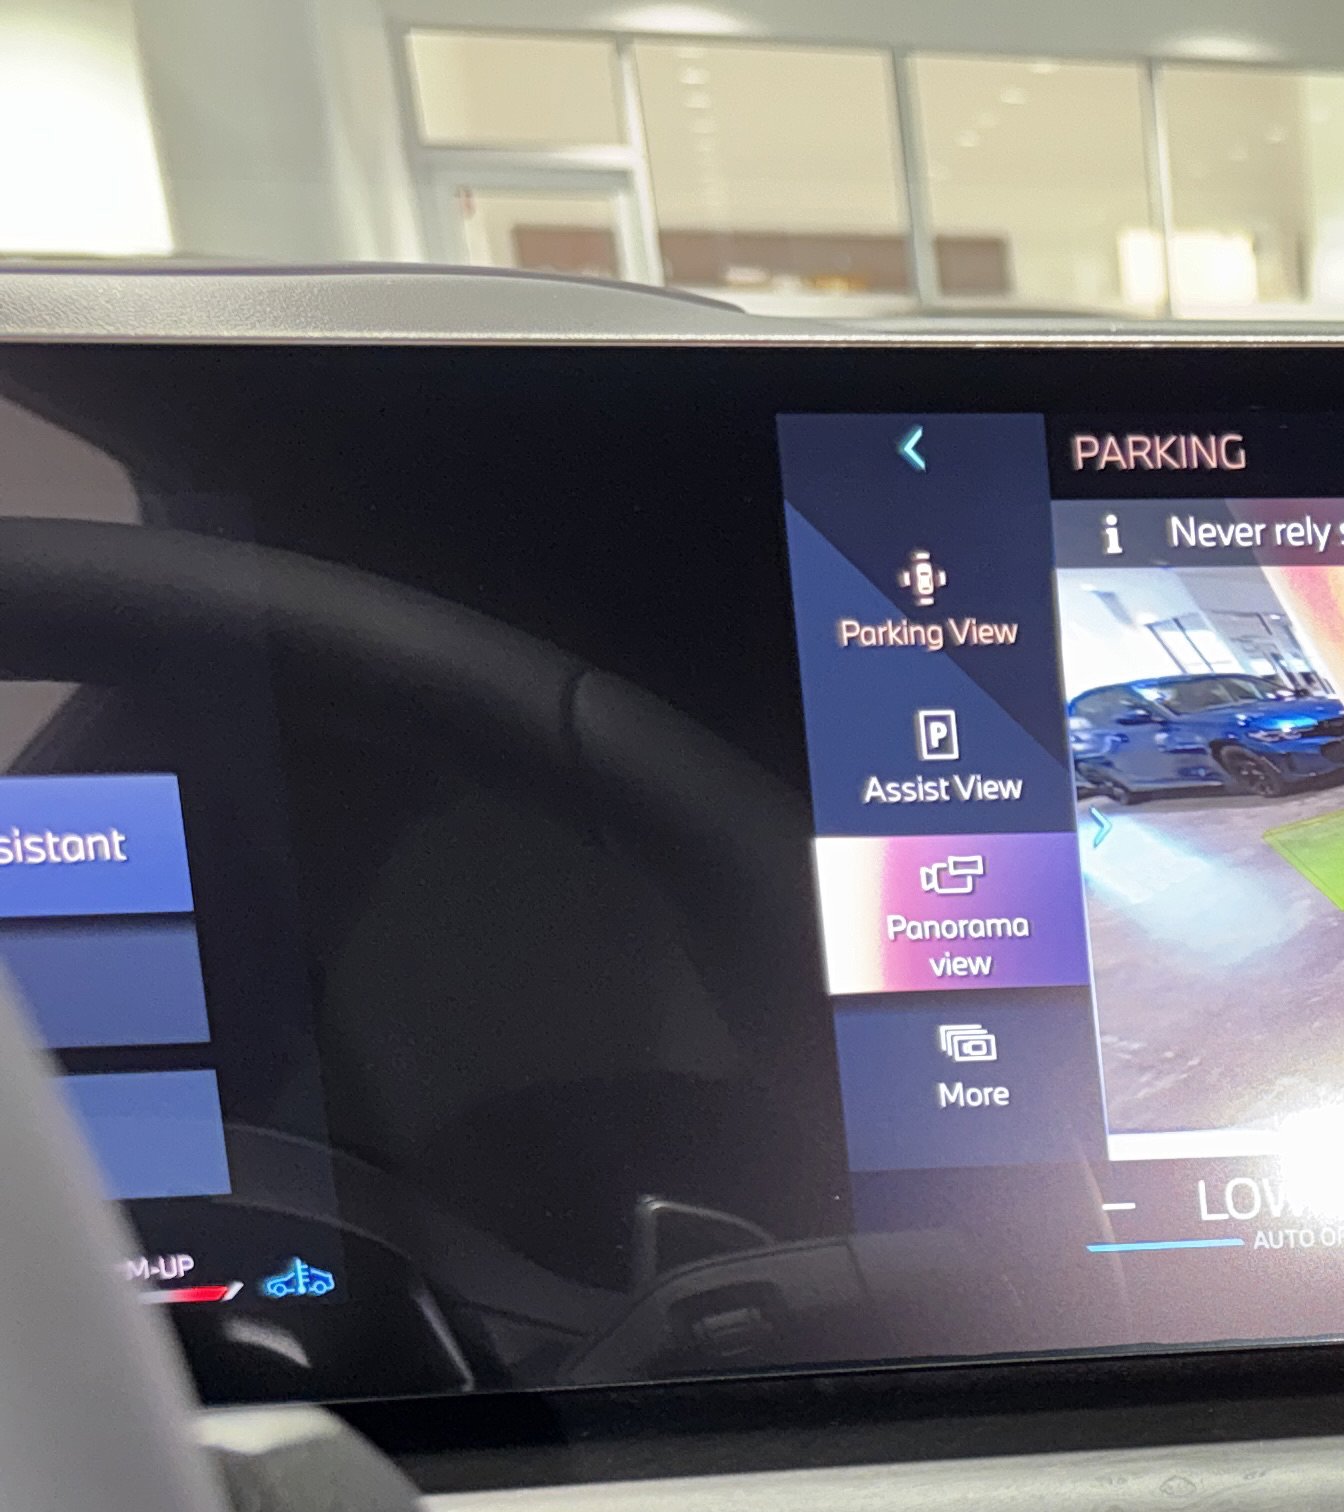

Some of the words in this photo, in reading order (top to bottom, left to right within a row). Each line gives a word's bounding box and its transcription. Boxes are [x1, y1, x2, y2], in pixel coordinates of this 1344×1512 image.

[1073, 434, 1247, 471] PARKING
[1170, 515, 1265, 549] Never
[1275, 515, 1331, 552] rely
[840, 618, 944, 651] Parking
[949, 617, 1018, 646] View
[863, 775, 950, 804] Assist
[954, 774, 1023, 801] View
[886, 914, 1030, 940] Panorama
[929, 951, 992, 977] view
[939, 1081, 1010, 1109] More
[1253, 1228, 1315, 1250] AUTO
